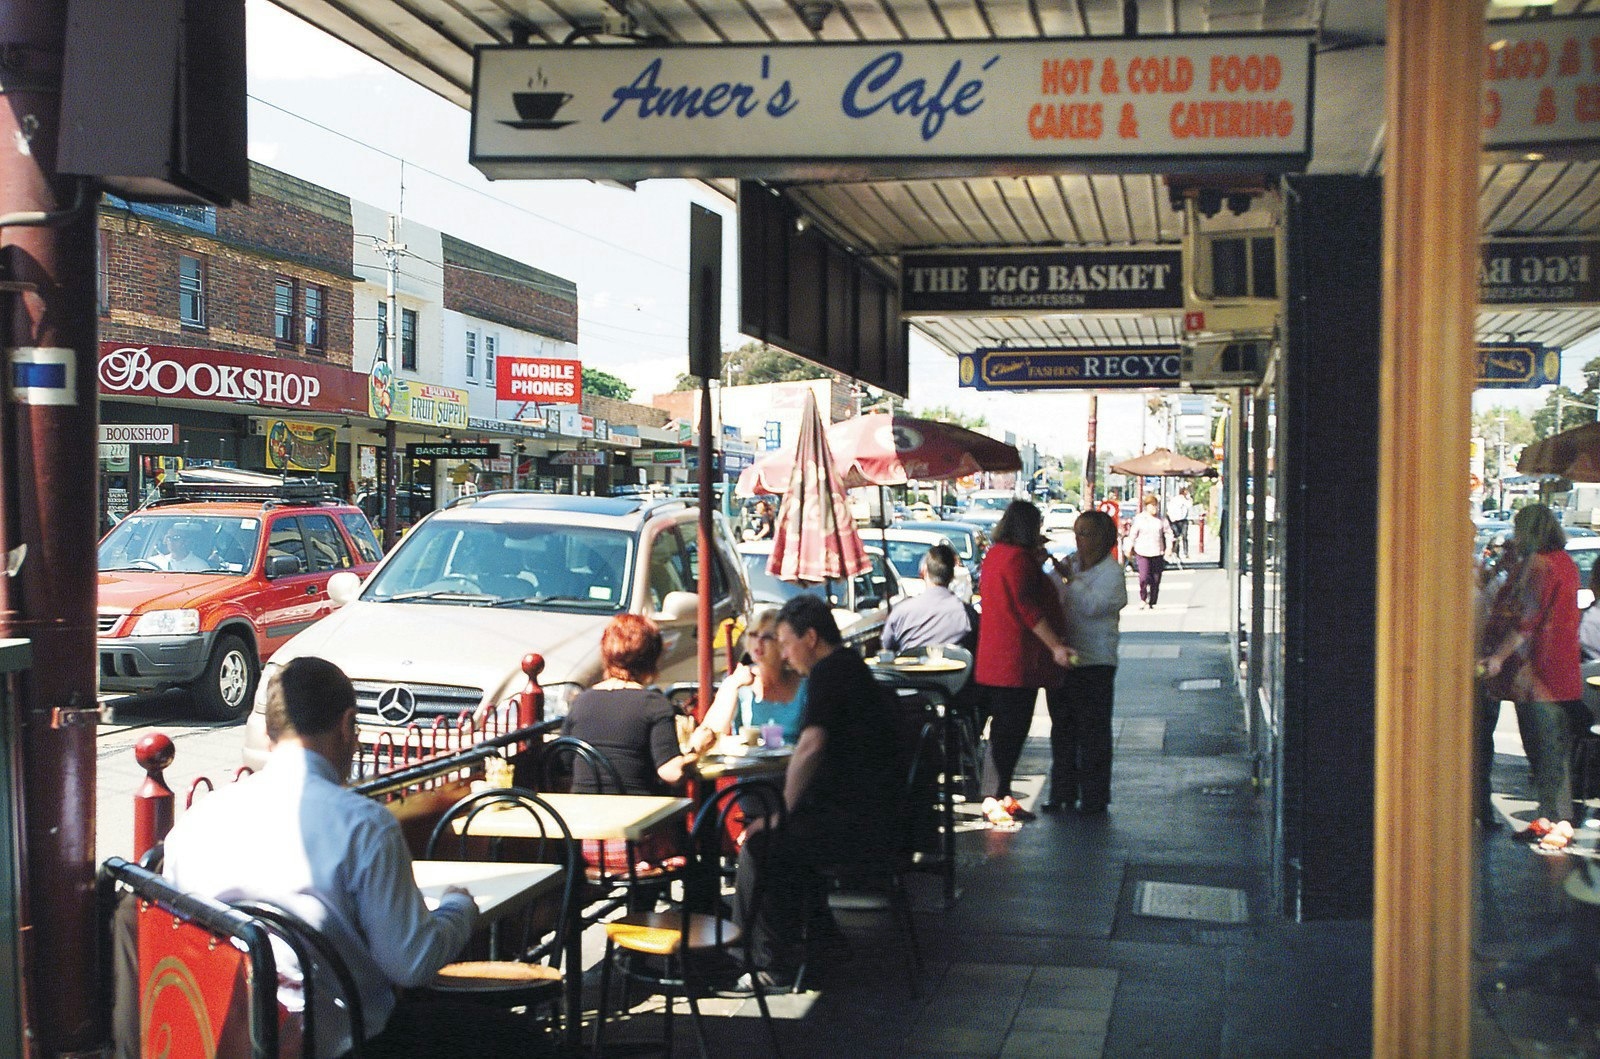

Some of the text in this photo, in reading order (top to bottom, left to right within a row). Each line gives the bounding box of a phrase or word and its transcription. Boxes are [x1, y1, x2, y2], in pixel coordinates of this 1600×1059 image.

[1041, 54, 1283, 96] HOT & COLD FOOD
[602, 51, 1000, 141] Amer's Café
[1028, 99, 1295, 140] CAKES & CATERING
[909, 263, 1171, 292] THE EGG BASKET
[991, 294, 1086, 306] DELICATESSEN
[98, 347, 321, 406] BOOKSHOP
[511, 362, 575, 380] MOBILE
[1083, 356, 1181, 378] RECYC
[511, 379, 575, 397] PHONES
[411, 397, 467, 427] FRUIT SUPPLY
[105, 427, 170, 442] BOOKSHOP
[415, 447, 488, 456] BAKER & SPICE
